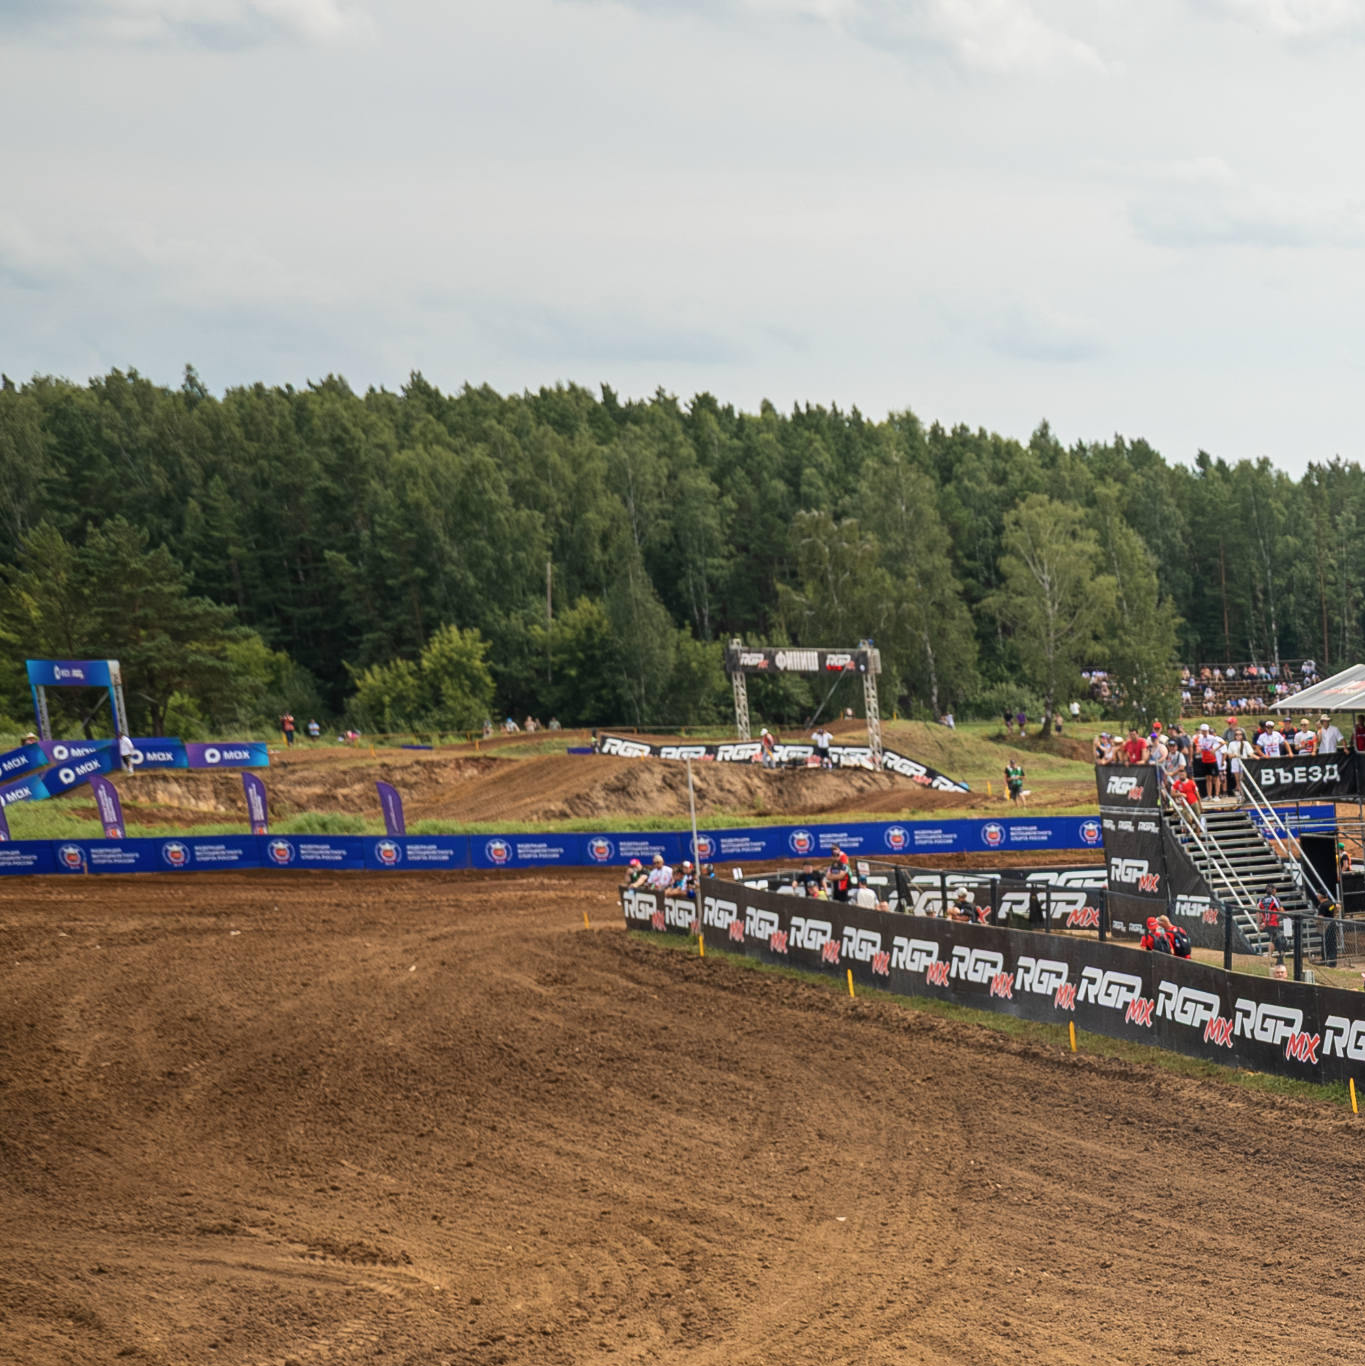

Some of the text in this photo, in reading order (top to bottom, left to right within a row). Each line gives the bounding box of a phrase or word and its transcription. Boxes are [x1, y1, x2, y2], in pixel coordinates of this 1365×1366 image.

[775, 651, 819, 672] ФИНИШ
[1260, 764, 1341, 786] ВЪЕЗД
[1110, 857, 1160, 893] RGP MX
[704, 896, 738, 930] RGP
[745, 906, 779, 940] RGP
[1066, 907, 1100, 927] MX
[789, 916, 832, 950] RGP
[841, 926, 881, 961] RGP
[891, 935, 940, 973] RGP
[950, 946, 1003, 983] RGP
